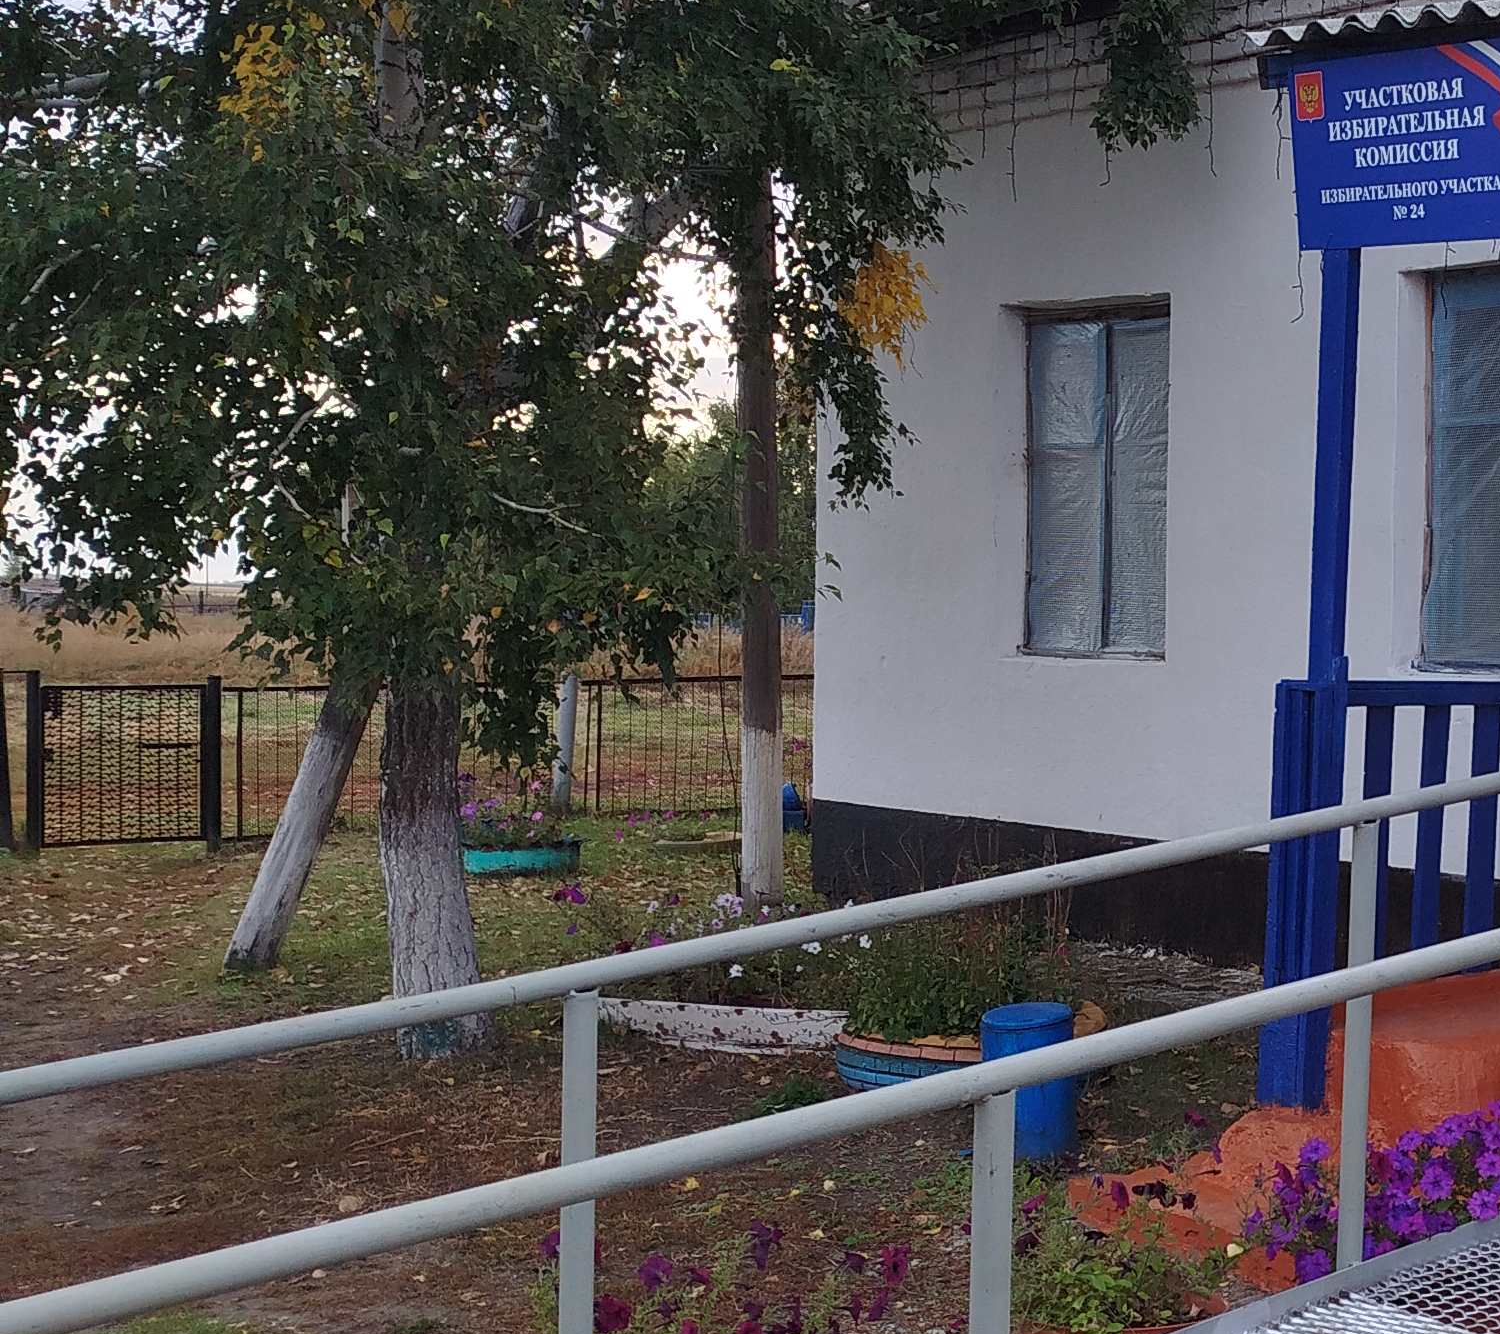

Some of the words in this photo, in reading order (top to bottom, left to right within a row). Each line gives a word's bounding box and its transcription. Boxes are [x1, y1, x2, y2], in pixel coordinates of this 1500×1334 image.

[1343, 78, 1464, 111] УЧАСТКОВАЯ
[1328, 106, 1486, 142] ИЗБИРАТЕЛЬНАЯ
[1354, 138, 1459, 168] КОМИССИЯ
[1321, 179, 1438, 204] ИЗБИРАТЕЛЬНОГО
[1393, 205, 1408, 220] №
[1410, 203, 1425, 219] 24
